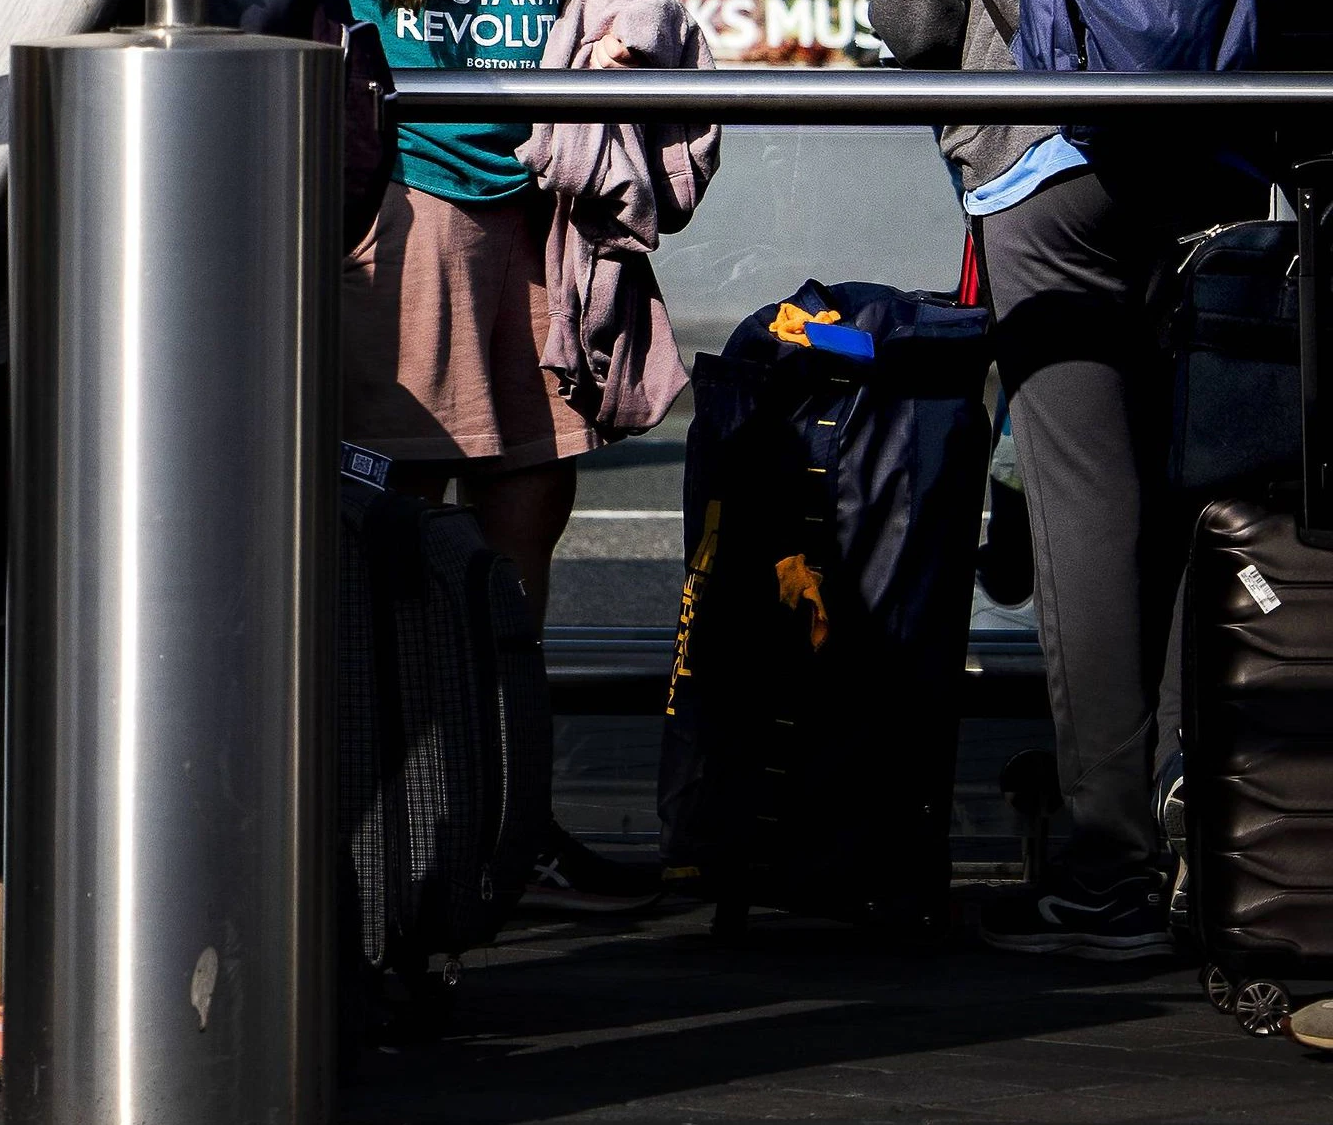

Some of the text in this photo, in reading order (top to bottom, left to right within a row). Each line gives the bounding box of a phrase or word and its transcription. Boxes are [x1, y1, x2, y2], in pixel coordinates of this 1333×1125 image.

[396, 6, 557, 49] REVOLUT
[466, 57, 537, 70] BOSTON TEA
